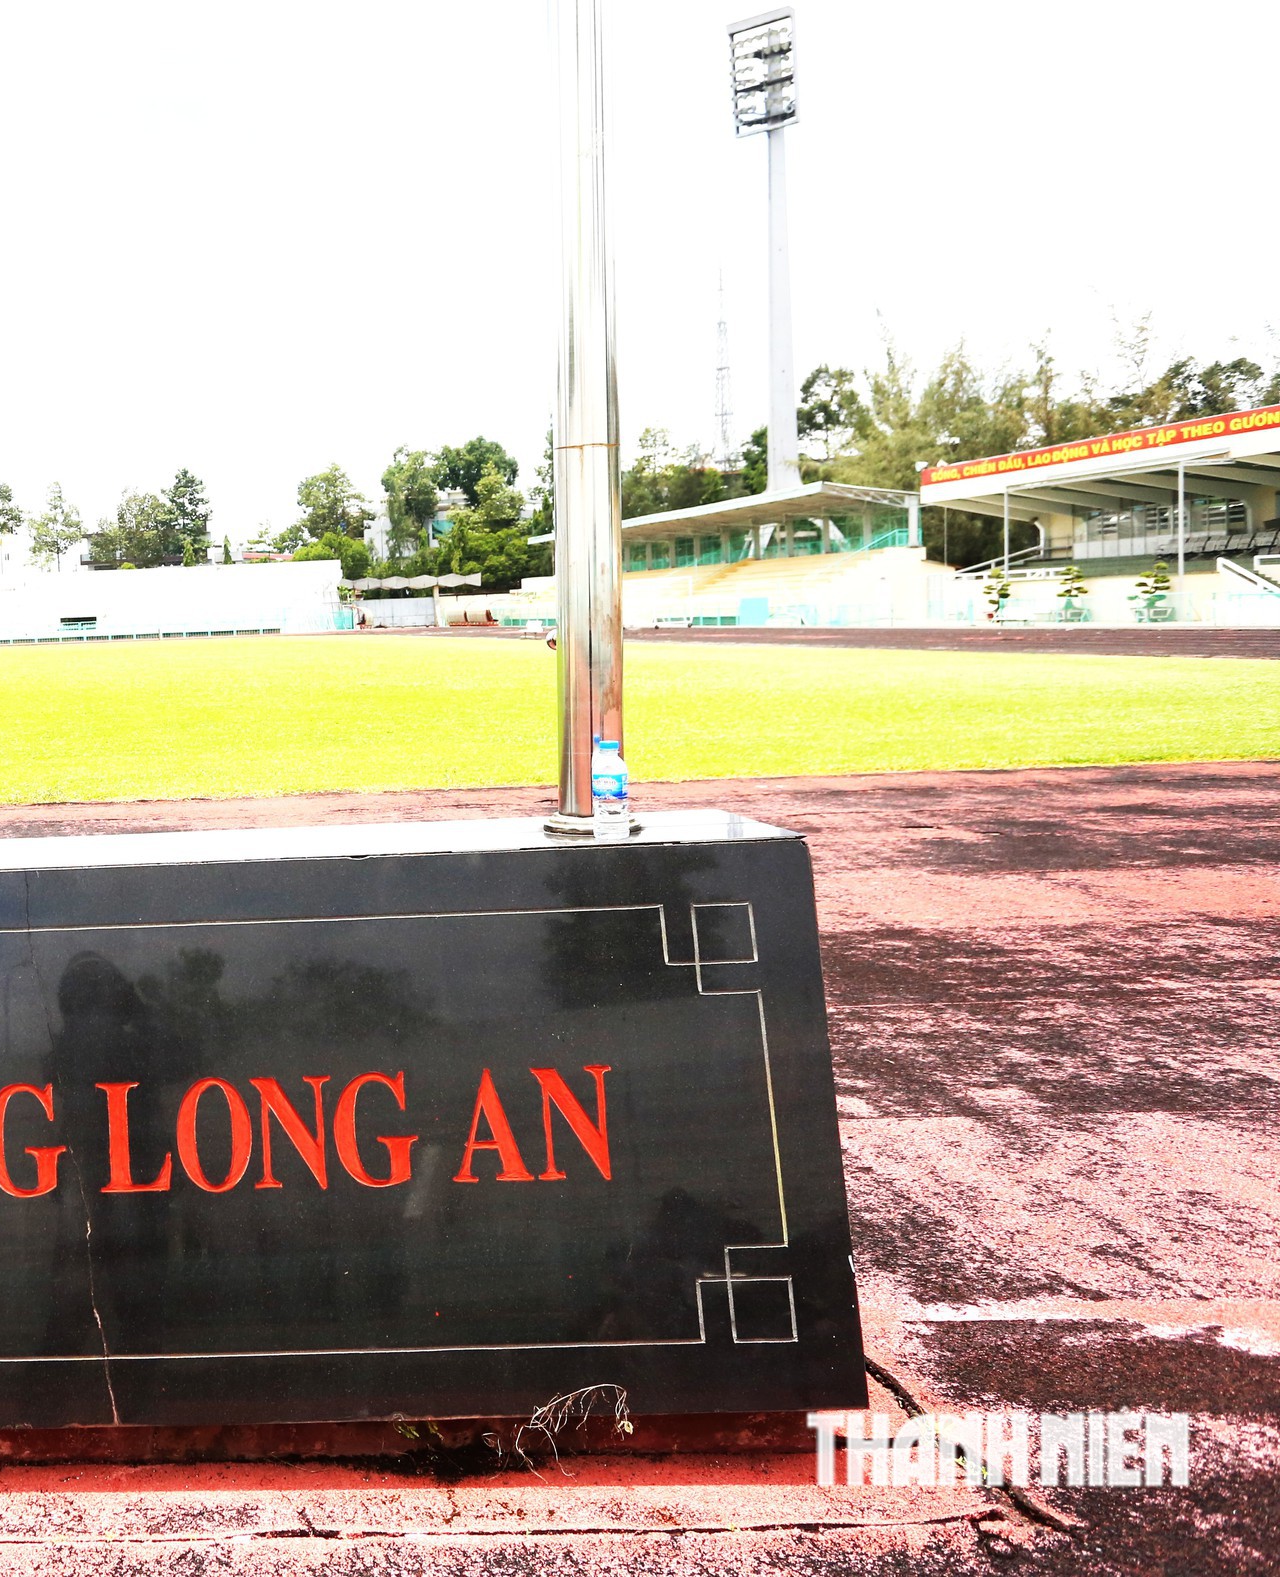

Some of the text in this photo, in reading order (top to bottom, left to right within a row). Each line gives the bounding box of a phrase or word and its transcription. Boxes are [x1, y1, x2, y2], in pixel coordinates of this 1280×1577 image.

[1027, 452, 1051, 466] LAO
[1052, 446, 1089, 463] ĐỘNG
[1091, 439, 1111, 455] VÀ
[1112, 435, 1143, 452] HỌC
[1146, 428, 1177, 446] TẬP
[1180, 421, 1225, 439] THEO
[94, 1070, 419, 1193] LONG
[452, 1063, 612, 1183] AN
